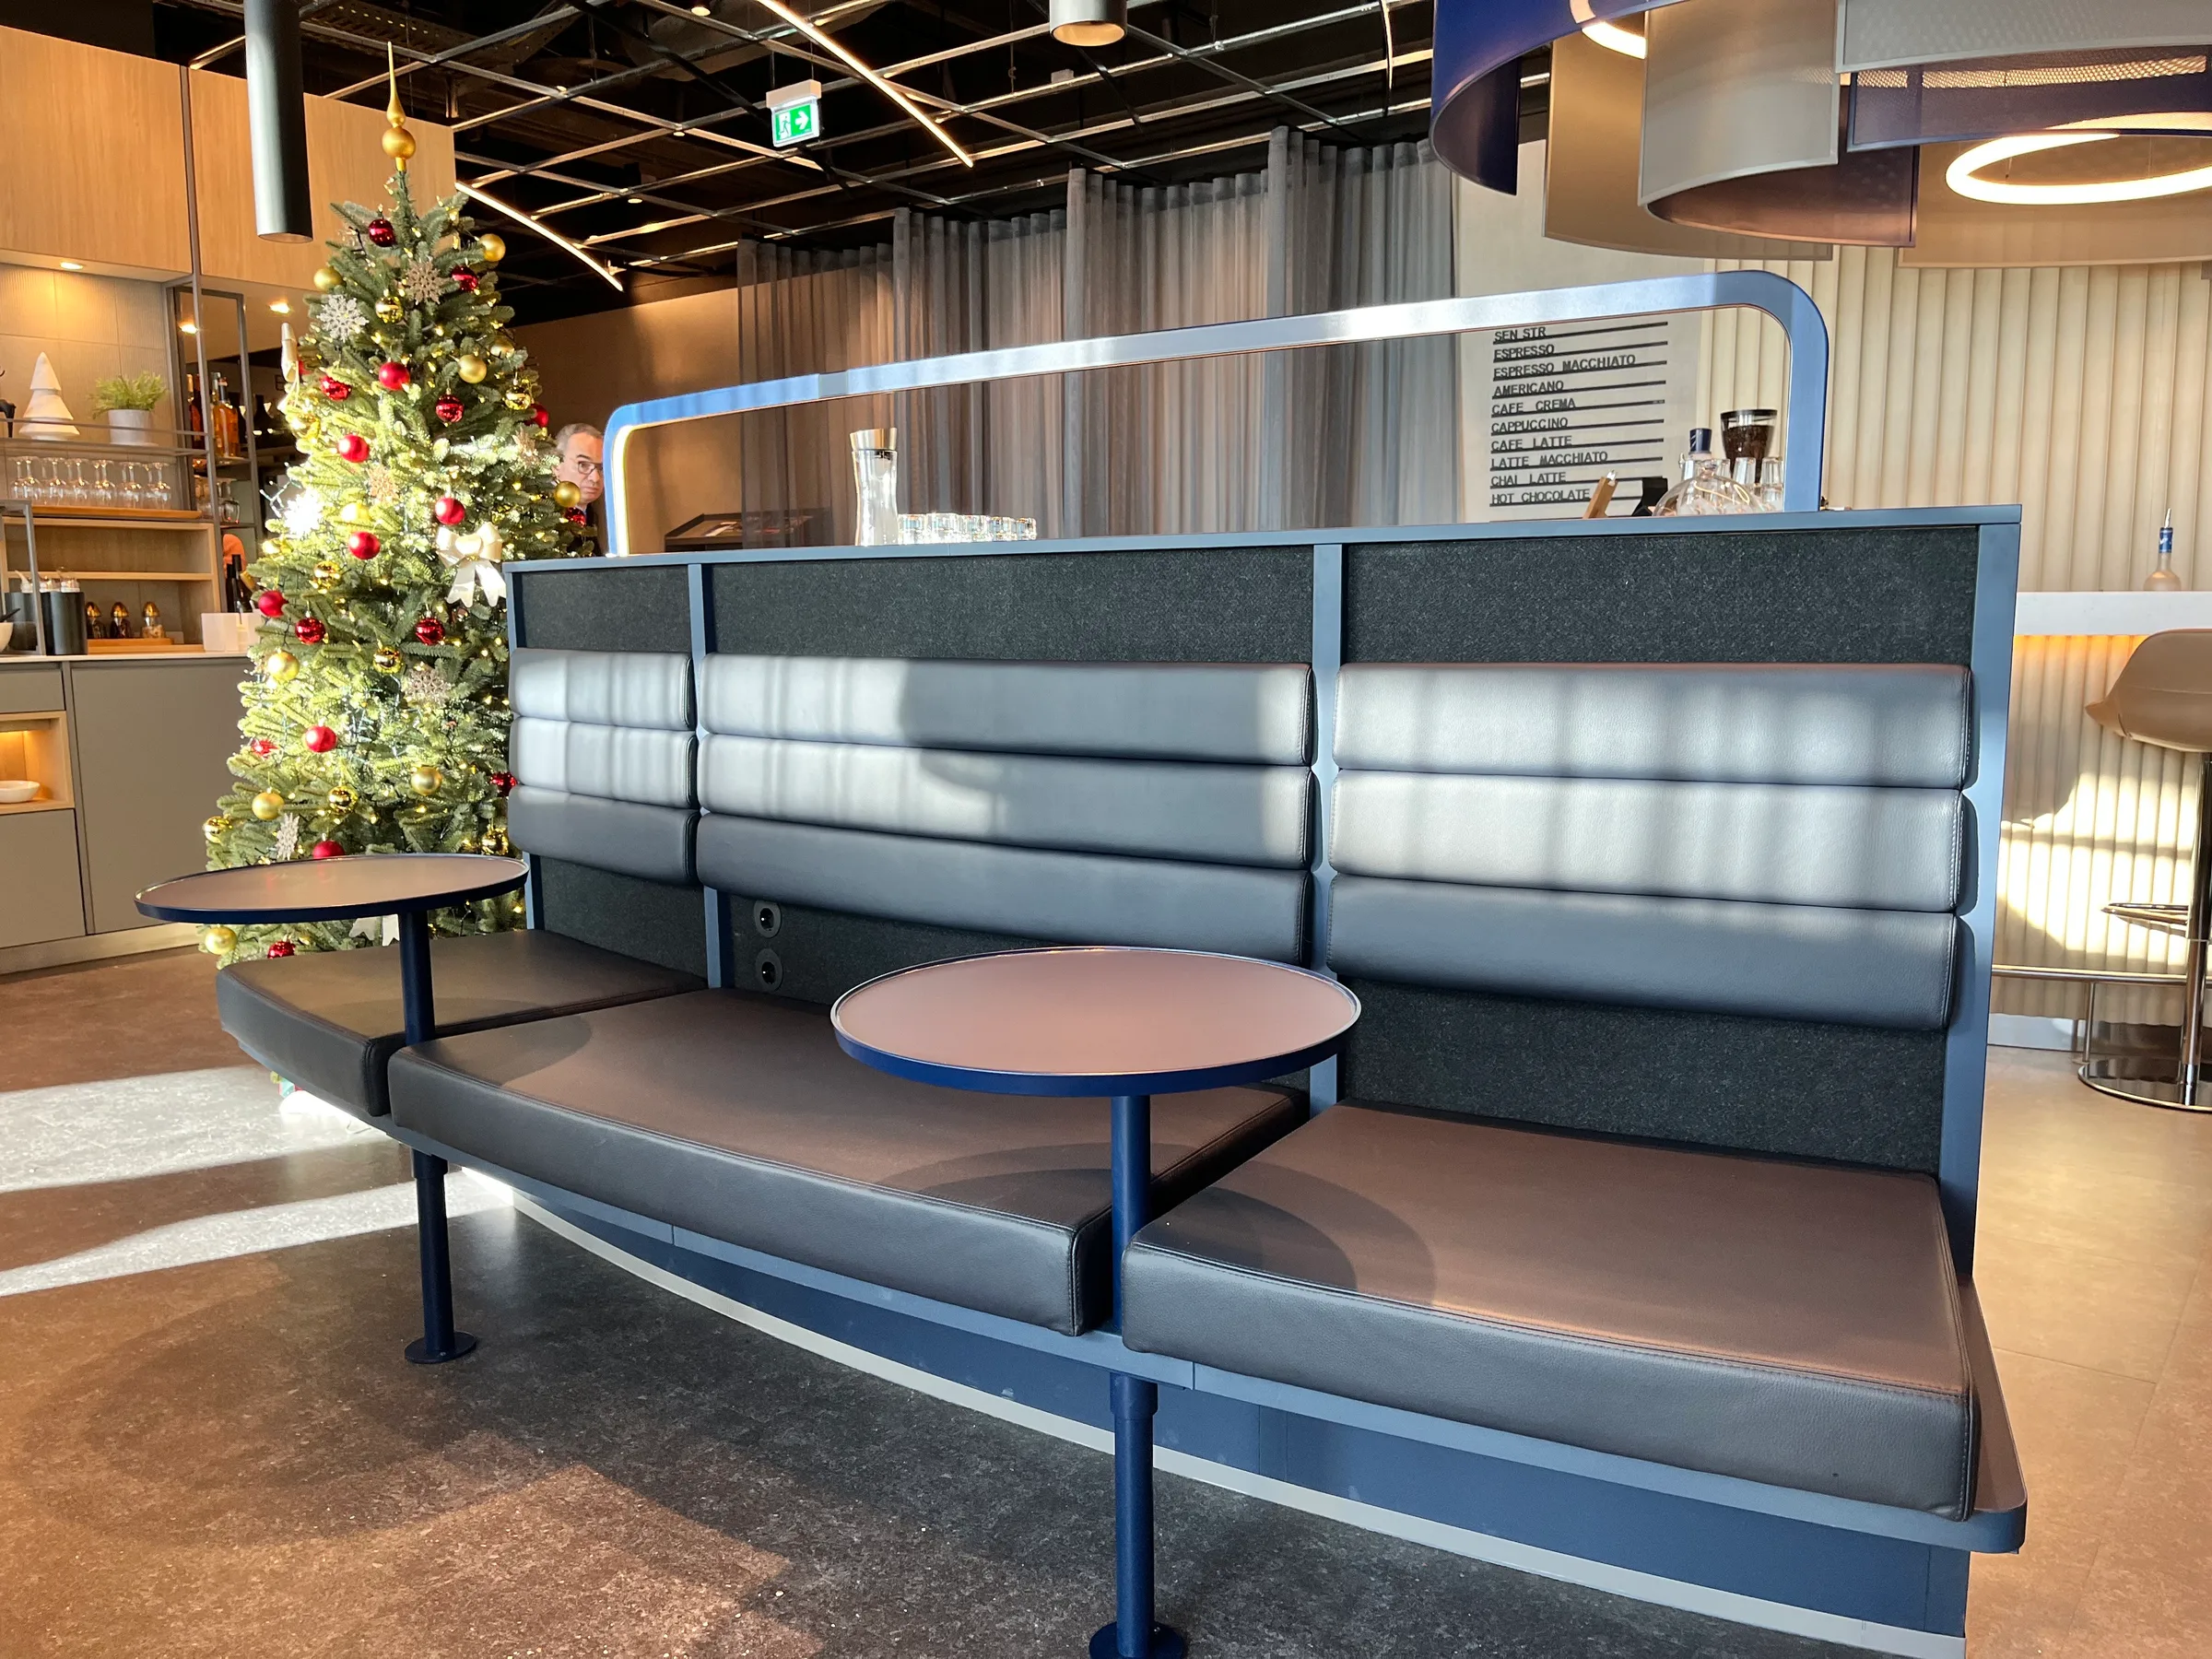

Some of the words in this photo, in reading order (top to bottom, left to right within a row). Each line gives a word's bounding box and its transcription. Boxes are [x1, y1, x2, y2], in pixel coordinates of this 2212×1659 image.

[1494, 329, 1518, 342] SEN
[1523, 326, 1547, 339] STR
[1494, 344, 1555, 359] ESPRESSO
[1494, 362, 1555, 378] ESPRESSO
[1562, 354, 1636, 371] MACCHIATO
[1493, 380, 1564, 396] AMERICANO
[1491, 402, 1524, 415] CAFE
[1535, 397, 1576, 411] CREMA
[1491, 417, 1568, 433] CAPPUCCINO
[1491, 438, 1524, 451] CAFE
[1533, 435, 1572, 447] LATTE
[1491, 455, 1529, 468] LATTE
[1539, 451, 1608, 465] MACCHIATO
[1491, 475, 1518, 487] CHAI
[1529, 471, 1566, 484] LATTE
[1491, 493, 1514, 504] HOT
[1521, 488, 1591, 502] CHOCOLATE
